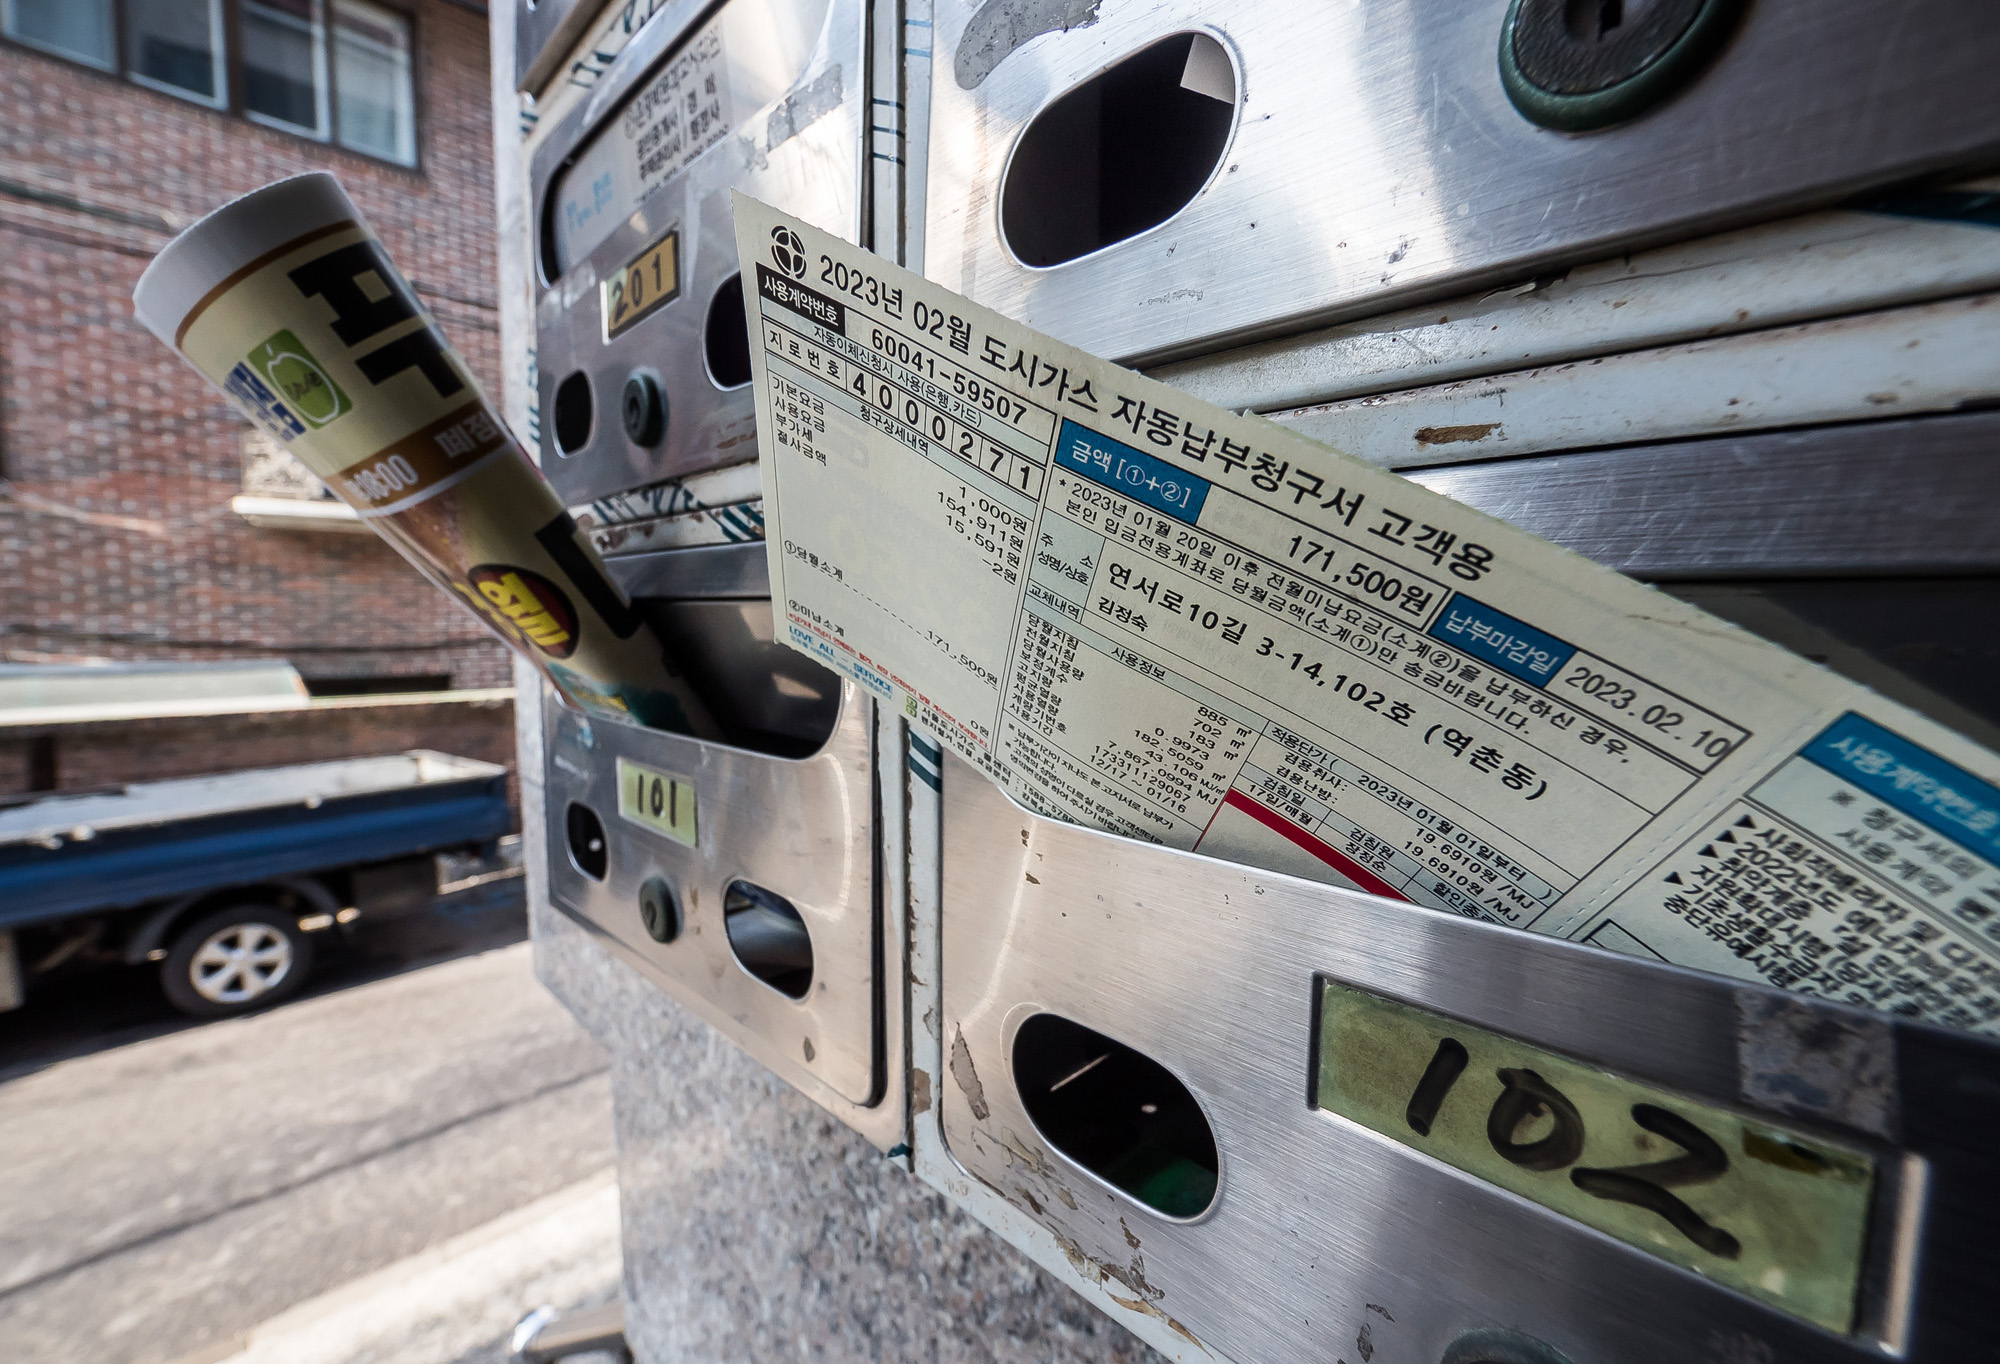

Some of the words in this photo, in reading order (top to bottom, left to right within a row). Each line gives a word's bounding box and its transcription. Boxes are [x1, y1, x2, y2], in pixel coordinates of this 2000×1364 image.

[611, 252, 663, 321] 201
[763, 274, 839, 327] 사용계약번호
[872, 328, 1027, 426] 60041-59507
[814, 326, 893, 379] 자동이체신청시
[772, 377, 825, 416] 기본요금
[774, 397, 826, 433] 사용요금
[775, 414, 814, 444] 부가세
[820, 254, 904, 320] 2023년
[912, 301, 972, 356] 02월
[979, 335, 1099, 413] 도시가스
[1112, 395, 1365, 527] 자동납부청구서
[1367, 508, 1494, 582] 고객용
[860, 405, 930, 457] 청구상세내역
[777, 431, 827, 468] 절사금액
[1072, 440, 1112, 474] 금액
[938, 491, 1024, 552] 154,911원
[959, 486, 1027, 534] 1,000원
[945, 515, 1020, 569] 15,591원
[1037, 550, 1089, 586] 성명/상호
[1098, 596, 1149, 632] 김정숙
[1288, 534, 1433, 617] 171,500원
[1029, 583, 1081, 619] 교체내역
[1066, 499, 1097, 526] 본인
[1105, 517, 1227, 585] 입금전용계좌로
[1401, 660, 1530, 735] 송금바랍니다.
[1072, 482, 1128, 520] 2023년
[1133, 511, 1173, 540] 01월
[1176, 530, 1217, 561] 20일
[1223, 551, 1261, 577] 이후
[1486, 677, 1575, 731] 납부하신
[1025, 627, 1076, 663] 전월지침
[1028, 614, 1080, 651] 당월지침
[1445, 609, 1561, 676] 납부마감일
[789, 625, 814, 645] LOVE
[819, 642, 836, 658] ALL
[853, 662, 893, 693] SERVICE
[927, 630, 998, 688] 171,500원
[1018, 663, 1053, 688] 고지량
[1020, 651, 1068, 684] 보정계수
[1023, 638, 1085, 681] 당월사용량
[1111, 646, 1166, 681] 사용정보
[1013, 682, 1059, 717] 사용열량
[1016, 671, 1062, 707] 평균열량
[1109, 561, 1248, 646] 연서로10길
[1255, 636, 1416, 727] 3-14,102호
[1424, 723, 1548, 801] (역촌동)
[922, 706, 976, 751] 서울도시가스
[970, 720, 989, 738] 0원
[1009, 703, 1053, 737] 사용기간
[1012, 693, 1067, 734] 계량기번호
[1193, 718, 1222, 738] 702
[1198, 706, 1228, 727] 885
[1134, 729, 1204, 771] 182.5059
[1154, 727, 1209, 761] 0.9973
[1189, 731, 1216, 750] 183
[1014, 747, 1038, 770] 고객의
[1040, 766, 1065, 788] 성명이
[1066, 784, 1094, 806] 다르실
[1095, 803, 1115, 821] 경우
[1017, 728, 1061, 765] 납부기간이
[1061, 759, 1089, 782] 지나도
[1090, 777, 1100, 788] 본
[1101, 785, 1141, 811] 고지서로
[1143, 807, 1174, 830] 납부가
[1089, 755, 1127, 779] 12/17
[1146, 787, 1187, 813] 01/16
[1094, 745, 1191, 802] 173311129067
[1145, 750, 1198, 781] 43.106
[637, 773, 677, 829] 101
[1051, 783, 1069, 800] 하여
[1070, 798, 1096, 819] 주시기
[1196, 789, 1218, 806] MJ
[1249, 784, 1313, 826] 17일/매월
[1263, 777, 1306, 807] 검침일
[1350, 828, 1395, 861] 검침원
[1358, 775, 1413, 811] 2023년
[1416, 808, 1454, 836] 01월
[1455, 832, 1527, 881] 01일부터
[1345, 842, 1387, 873] 장정순
[1416, 827, 1498, 884] 19.6910원
[1497, 884, 1535, 910] /MJ
[1734, 841, 1846, 914] 2022년도
[1404, 841, 1485, 898] 19.6910원
[1484, 897, 1521, 922] /MJ
[1405, 1037, 1742, 1261] 102
